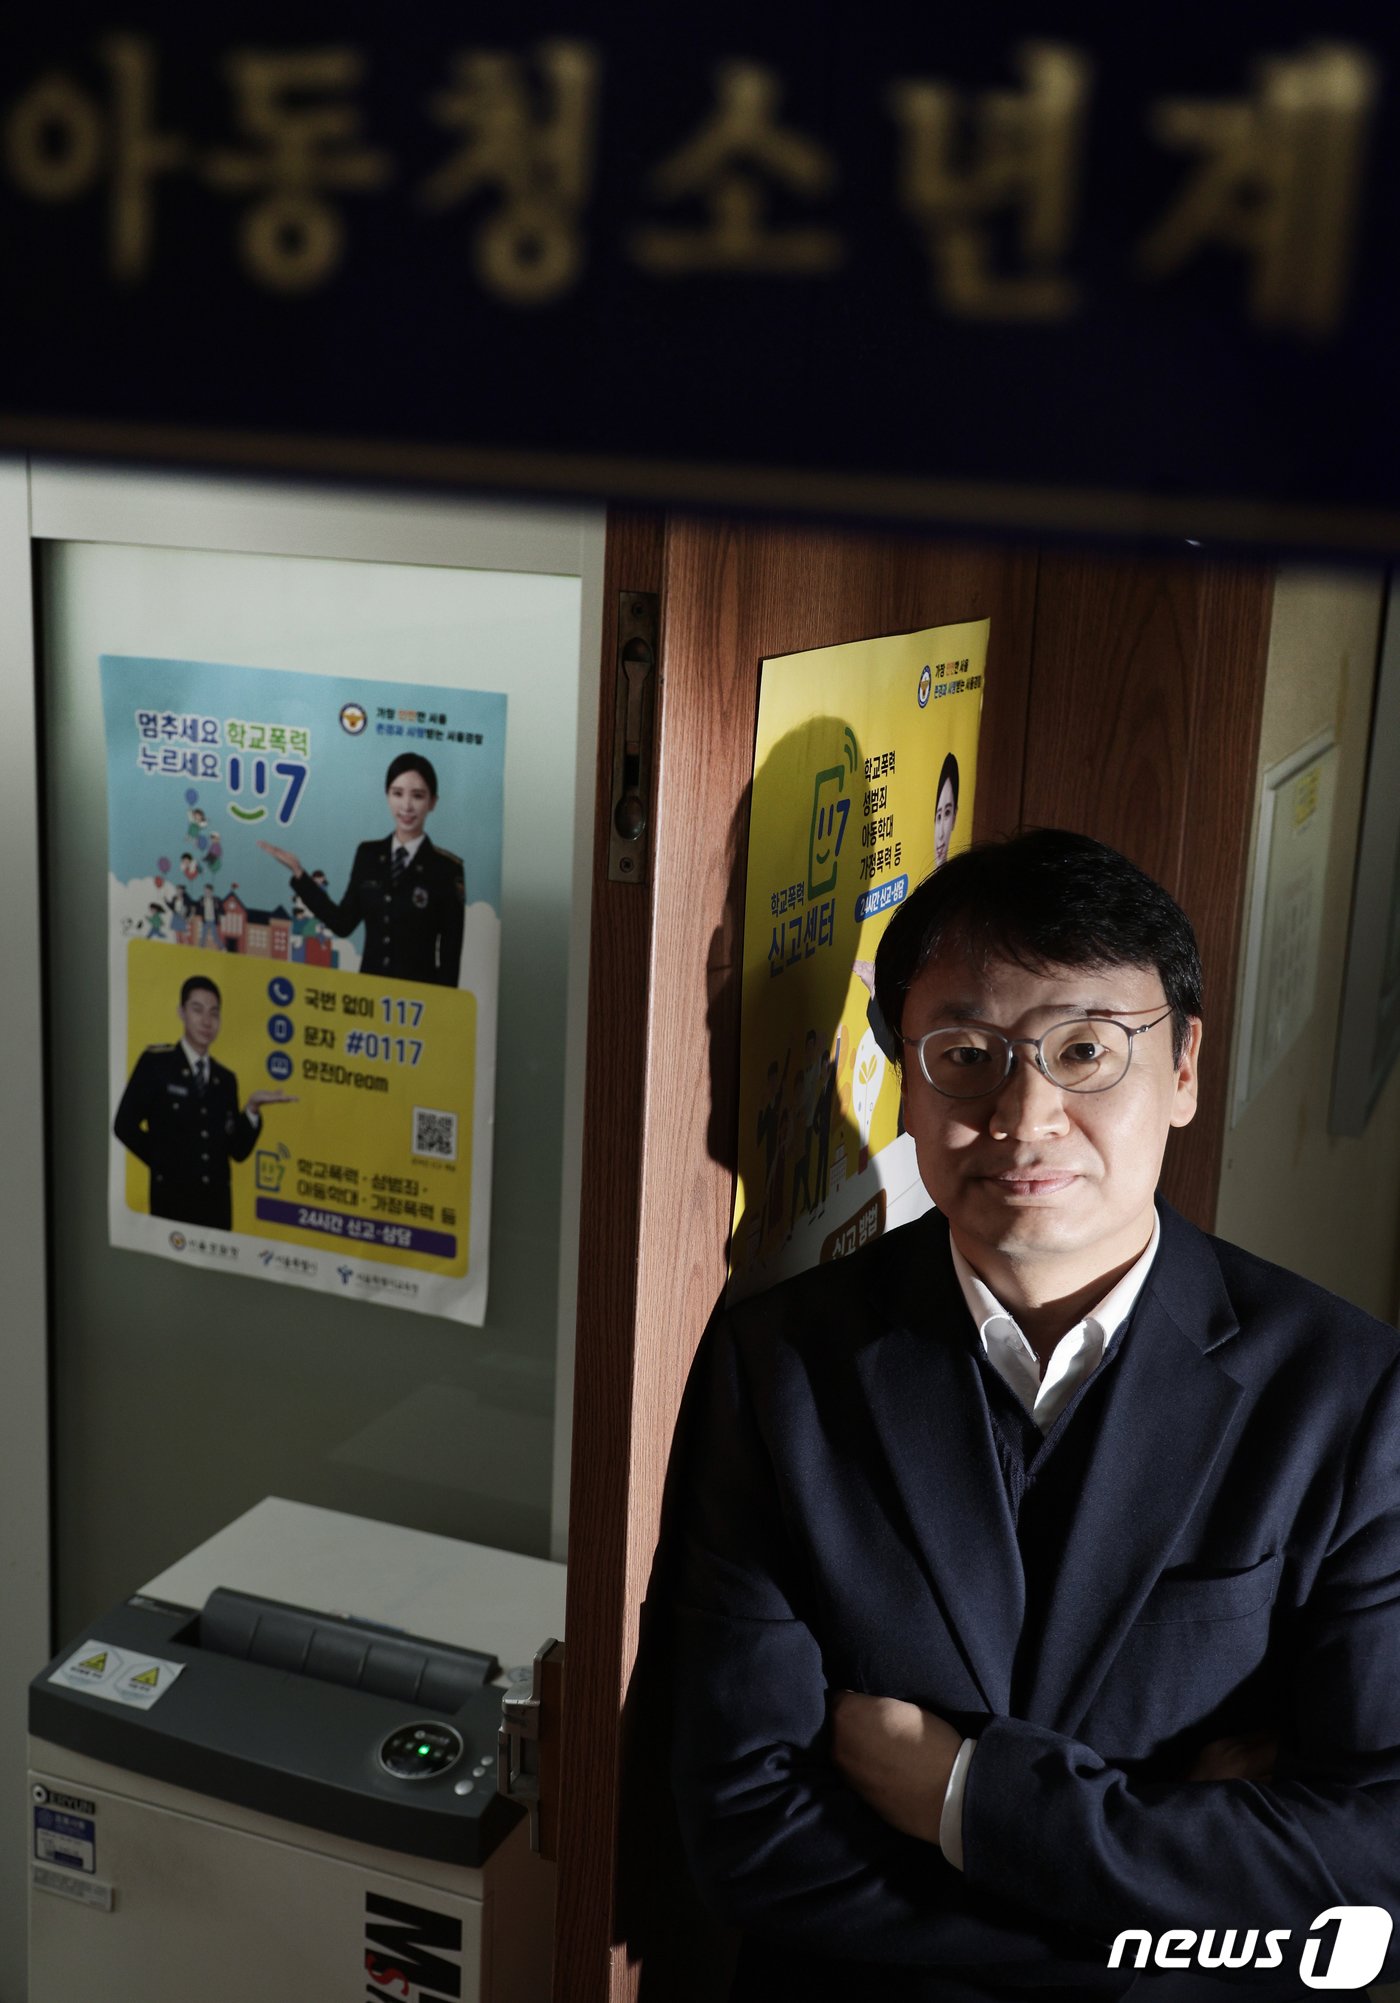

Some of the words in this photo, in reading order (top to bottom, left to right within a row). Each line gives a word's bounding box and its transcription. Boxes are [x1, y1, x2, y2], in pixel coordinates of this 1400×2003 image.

[4, 28, 1380, 348] 아동청소년계
[139, 713, 219, 745] 멈추세요
[227, 722, 309, 756] 학교폭력
[140, 747, 219, 779] 누르세요
[230, 758, 307, 823] 117
[864, 750, 896, 782] 학교폭력
[862, 785, 888, 816] 성범죄
[861, 815, 894, 848] 아동학대
[859, 848, 892, 880] 가정폭력
[894, 842, 902, 866] 등
[771, 881, 804, 917] 학교폭력
[860, 891, 880, 916] 24시간
[768, 898, 835, 977] 신고센터
[304, 988, 337, 1012] 국번
[342, 992, 374, 1018] 없이
[381, 998, 425, 1027] 117
[303, 1026, 336, 1049] 문자
[345, 1032, 423, 1066] #0117
[302, 1059, 388, 1091] 안전Dream
[296, 1158, 359, 1184] 학교폭력
[296, 1179, 359, 1207] 아동학대
[371, 1194, 435, 1220] 가정폭력
[298, 1208, 345, 1233] 24시간
[832, 1224, 857, 1260] 신고
[859, 1203, 878, 1247] 방법
